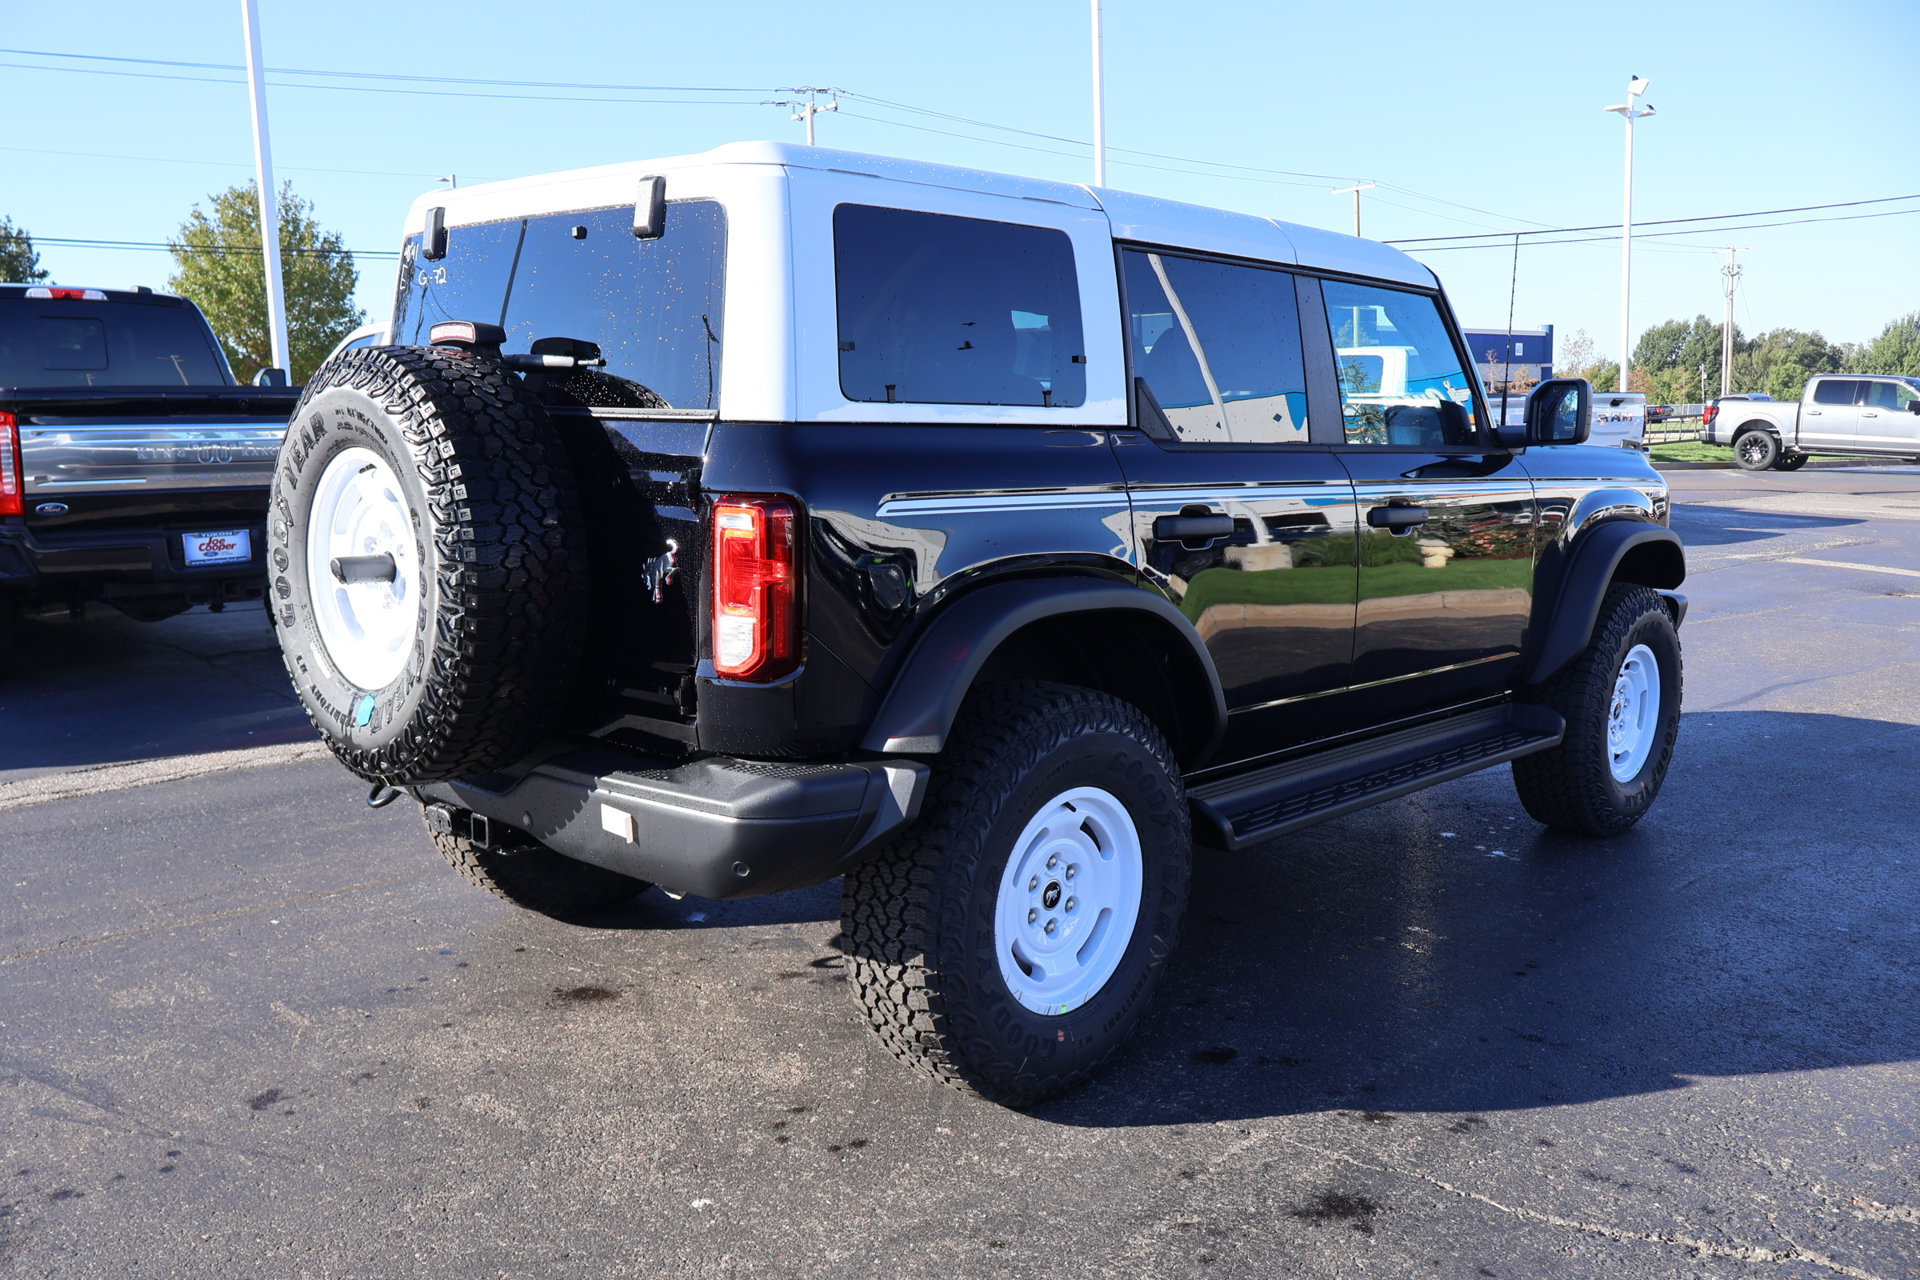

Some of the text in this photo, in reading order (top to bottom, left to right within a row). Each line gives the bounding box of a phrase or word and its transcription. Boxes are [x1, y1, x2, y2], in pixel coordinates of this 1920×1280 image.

[418, 266, 448, 286] G-72
[1596, 412, 1633, 423] RAM
[137, 447, 277, 460] KING RANC
[273, 410, 328, 629] GOODYEAR
[198, 543, 237, 552] Cooper
[207, 536, 226, 546] Joe
[1107, 750, 1182, 945] GOODYEAR
[975, 862, 1057, 1063] GOODYEAR
